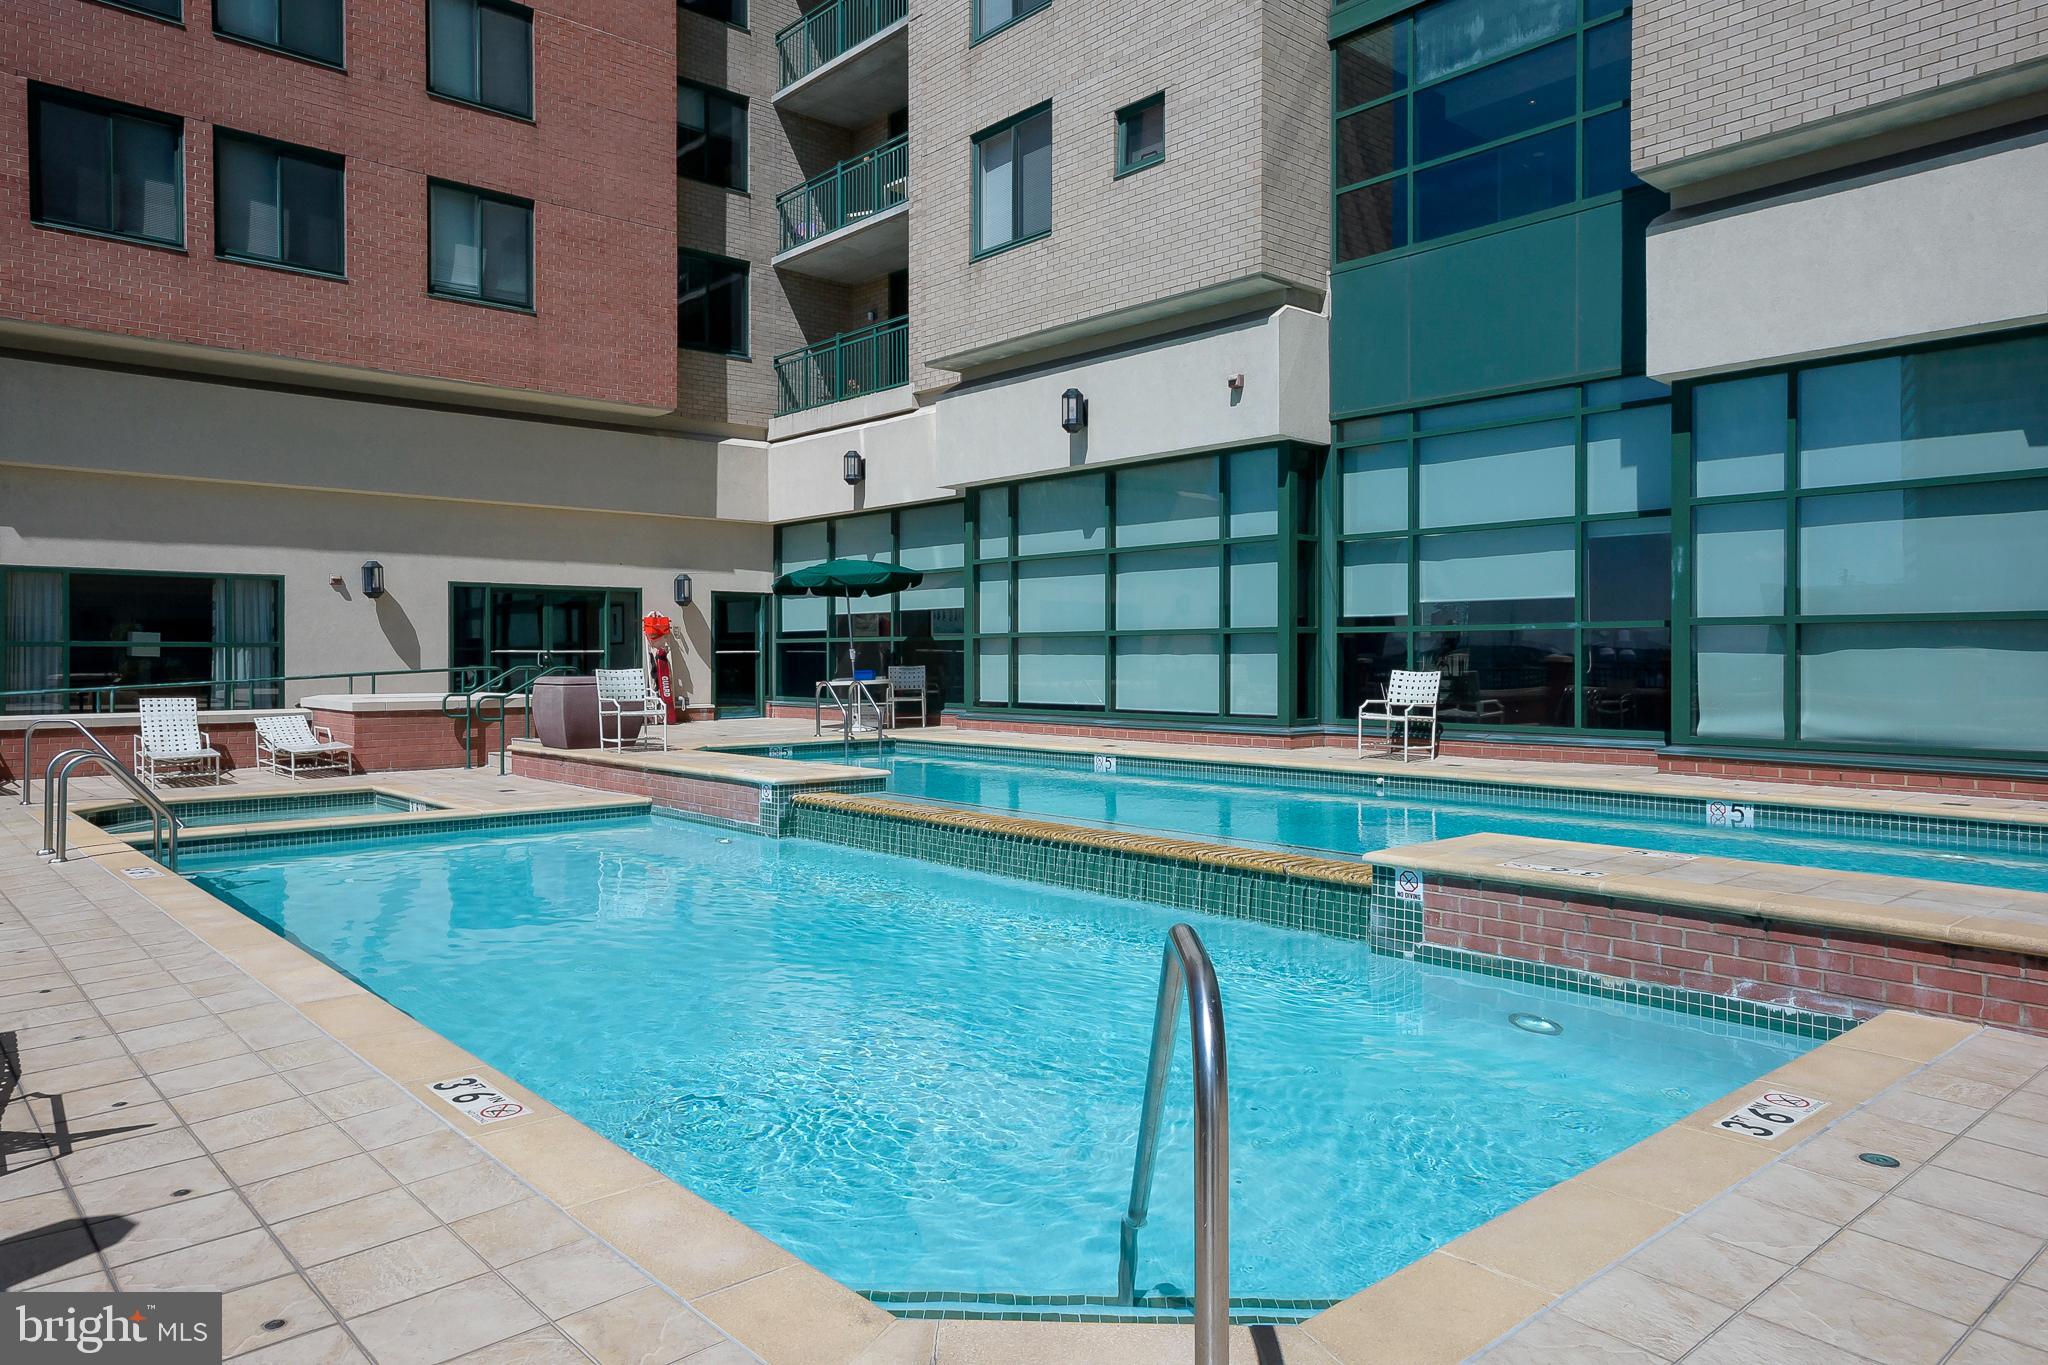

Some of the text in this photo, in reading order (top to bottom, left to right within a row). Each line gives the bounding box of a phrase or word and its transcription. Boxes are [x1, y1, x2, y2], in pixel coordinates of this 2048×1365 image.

[662, 676, 670, 697] GUARD
[1105, 756, 1112, 769] 5
[1731, 803, 1744, 823] 5
[1405, 893, 1421, 901] DIVING
[433, 1078, 478, 1091] 3
[452, 1092, 497, 1103] 6
[1721, 1120, 1773, 1137] 3
[1747, 1107, 1795, 1124] 6
